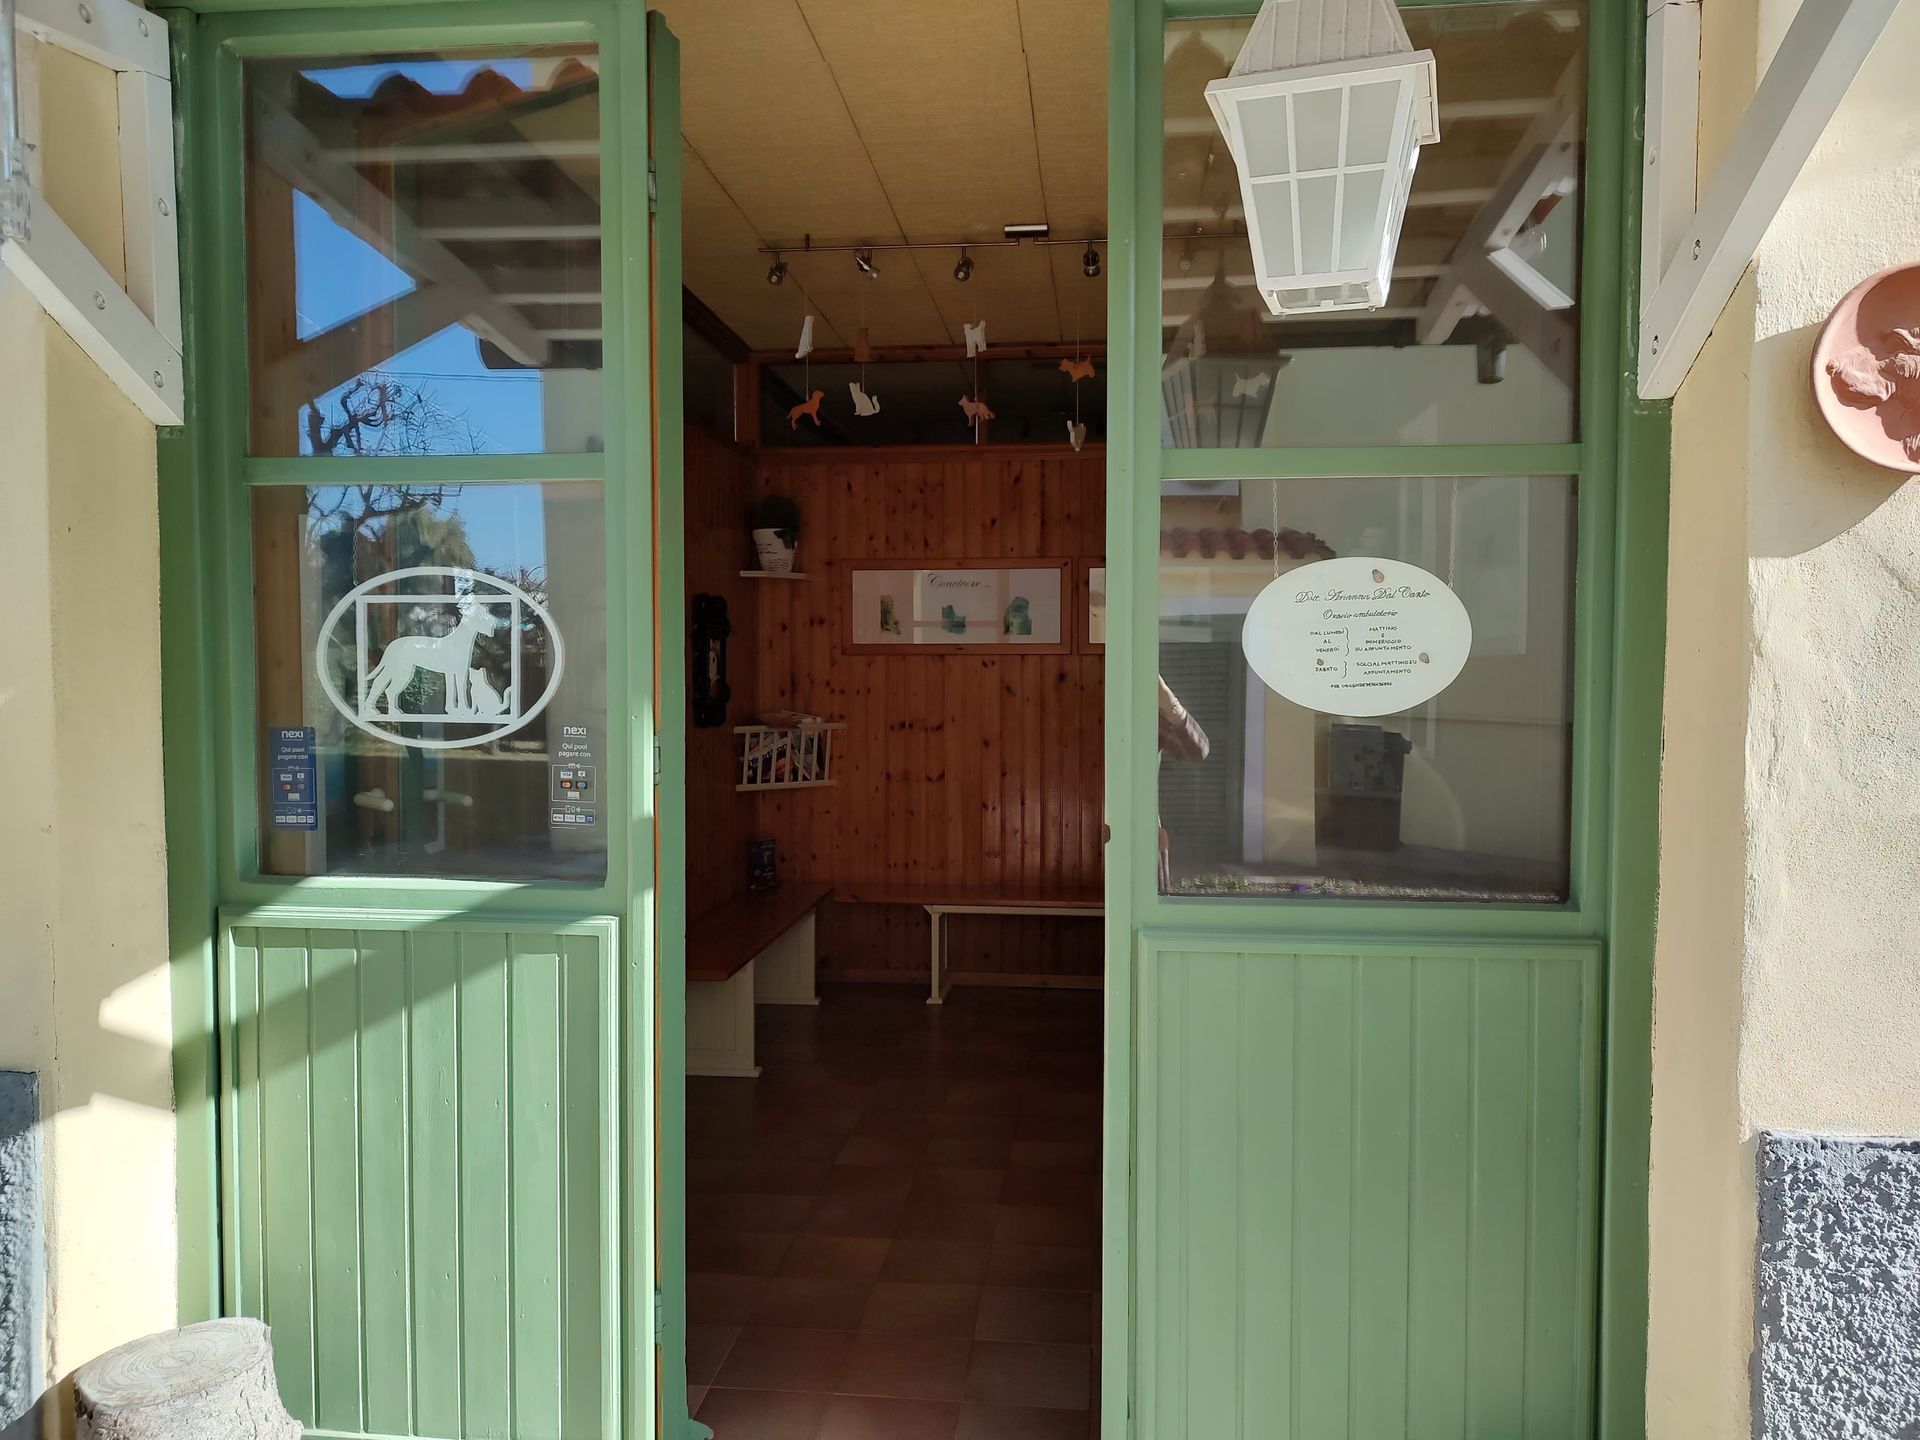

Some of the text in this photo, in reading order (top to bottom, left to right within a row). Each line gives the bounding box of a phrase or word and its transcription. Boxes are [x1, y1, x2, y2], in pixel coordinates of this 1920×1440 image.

[1324, 588, 1371, 601] Arianna
[1372, 587, 1397, 600] Dal
[1398, 585, 1431, 598] Canto
[1323, 609, 1398, 620] Orario ambulatorio
[281, 730, 304, 738] nexi
[563, 726, 587, 735] nexi
[574, 743, 588, 751] puoi
